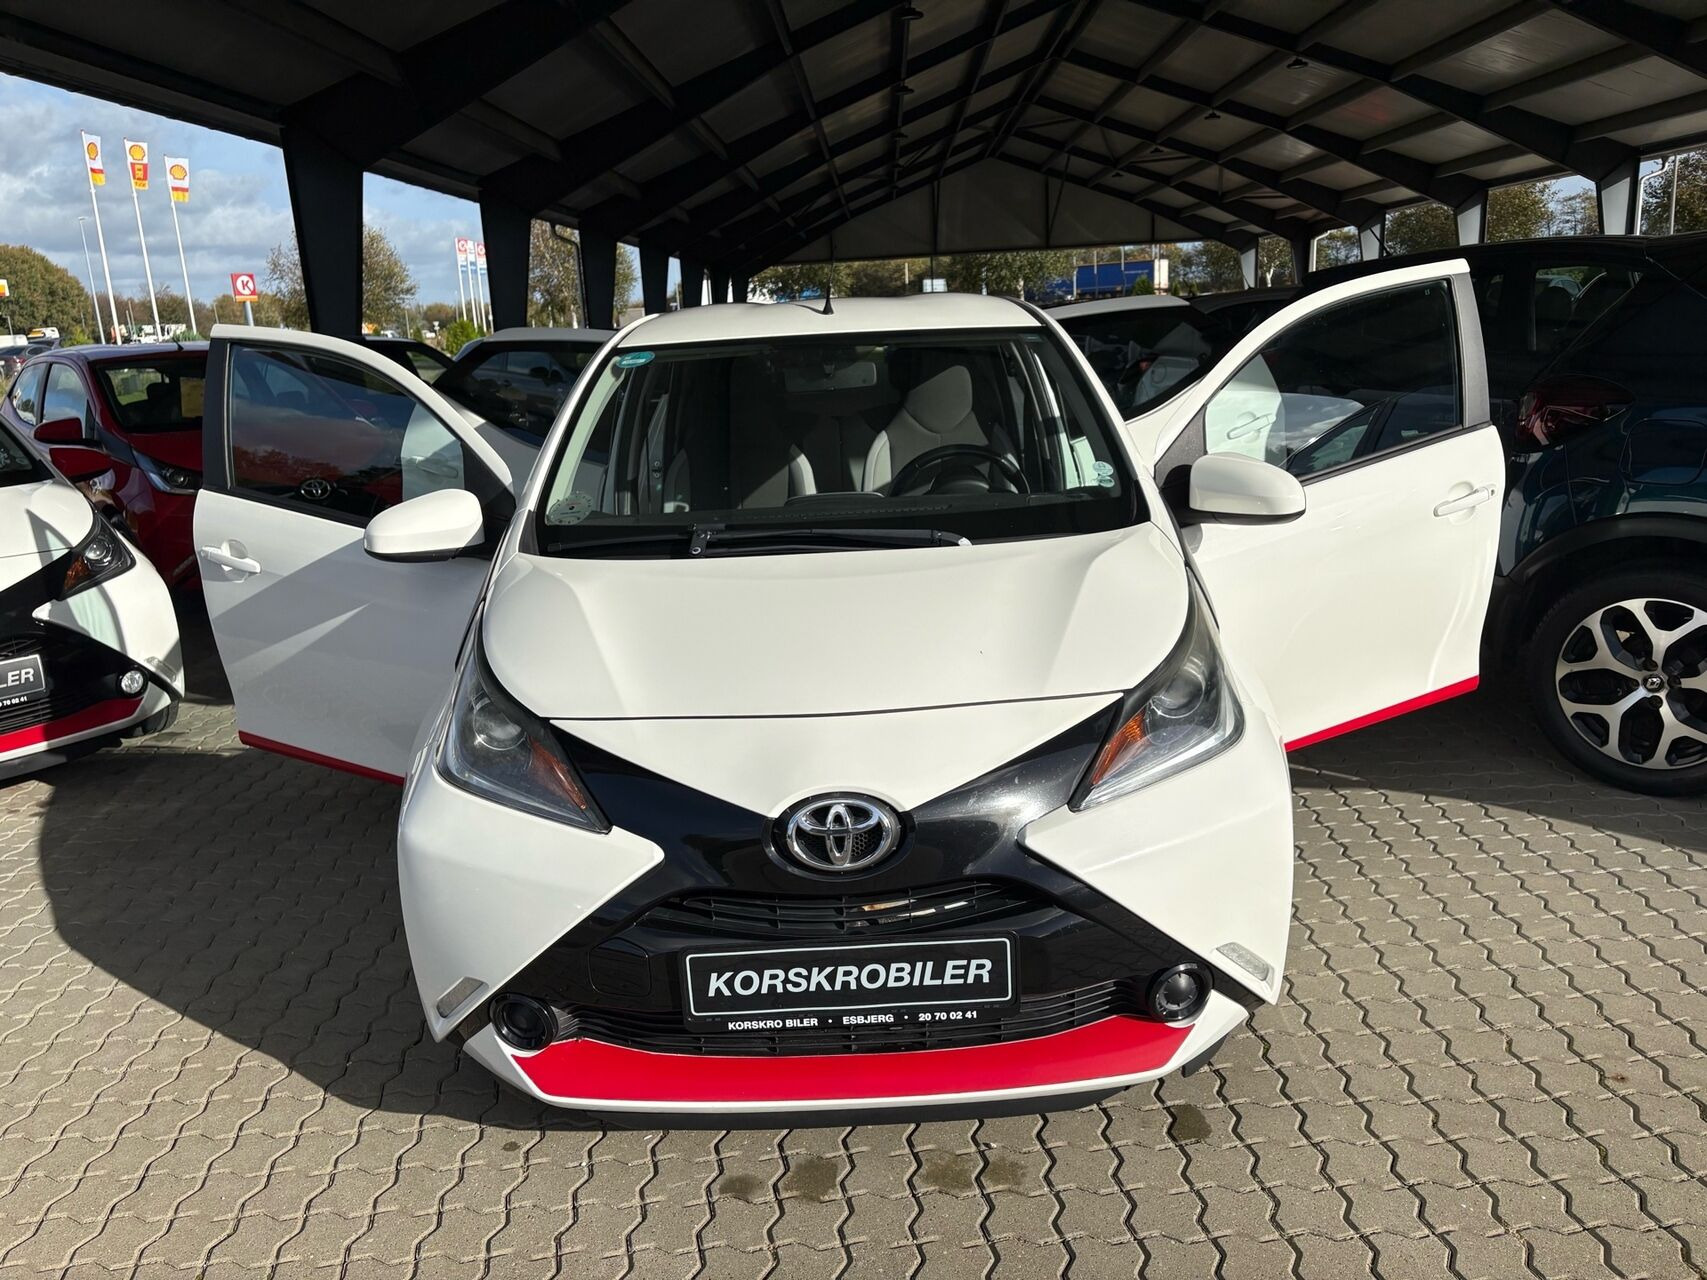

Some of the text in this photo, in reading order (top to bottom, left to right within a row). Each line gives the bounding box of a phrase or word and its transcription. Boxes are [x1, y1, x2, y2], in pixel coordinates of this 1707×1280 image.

[707, 958, 993, 997] KORSKROBILER
[728, 1010, 978, 1030] KORSKRO BILER ESBJERG 20 70 02 41
